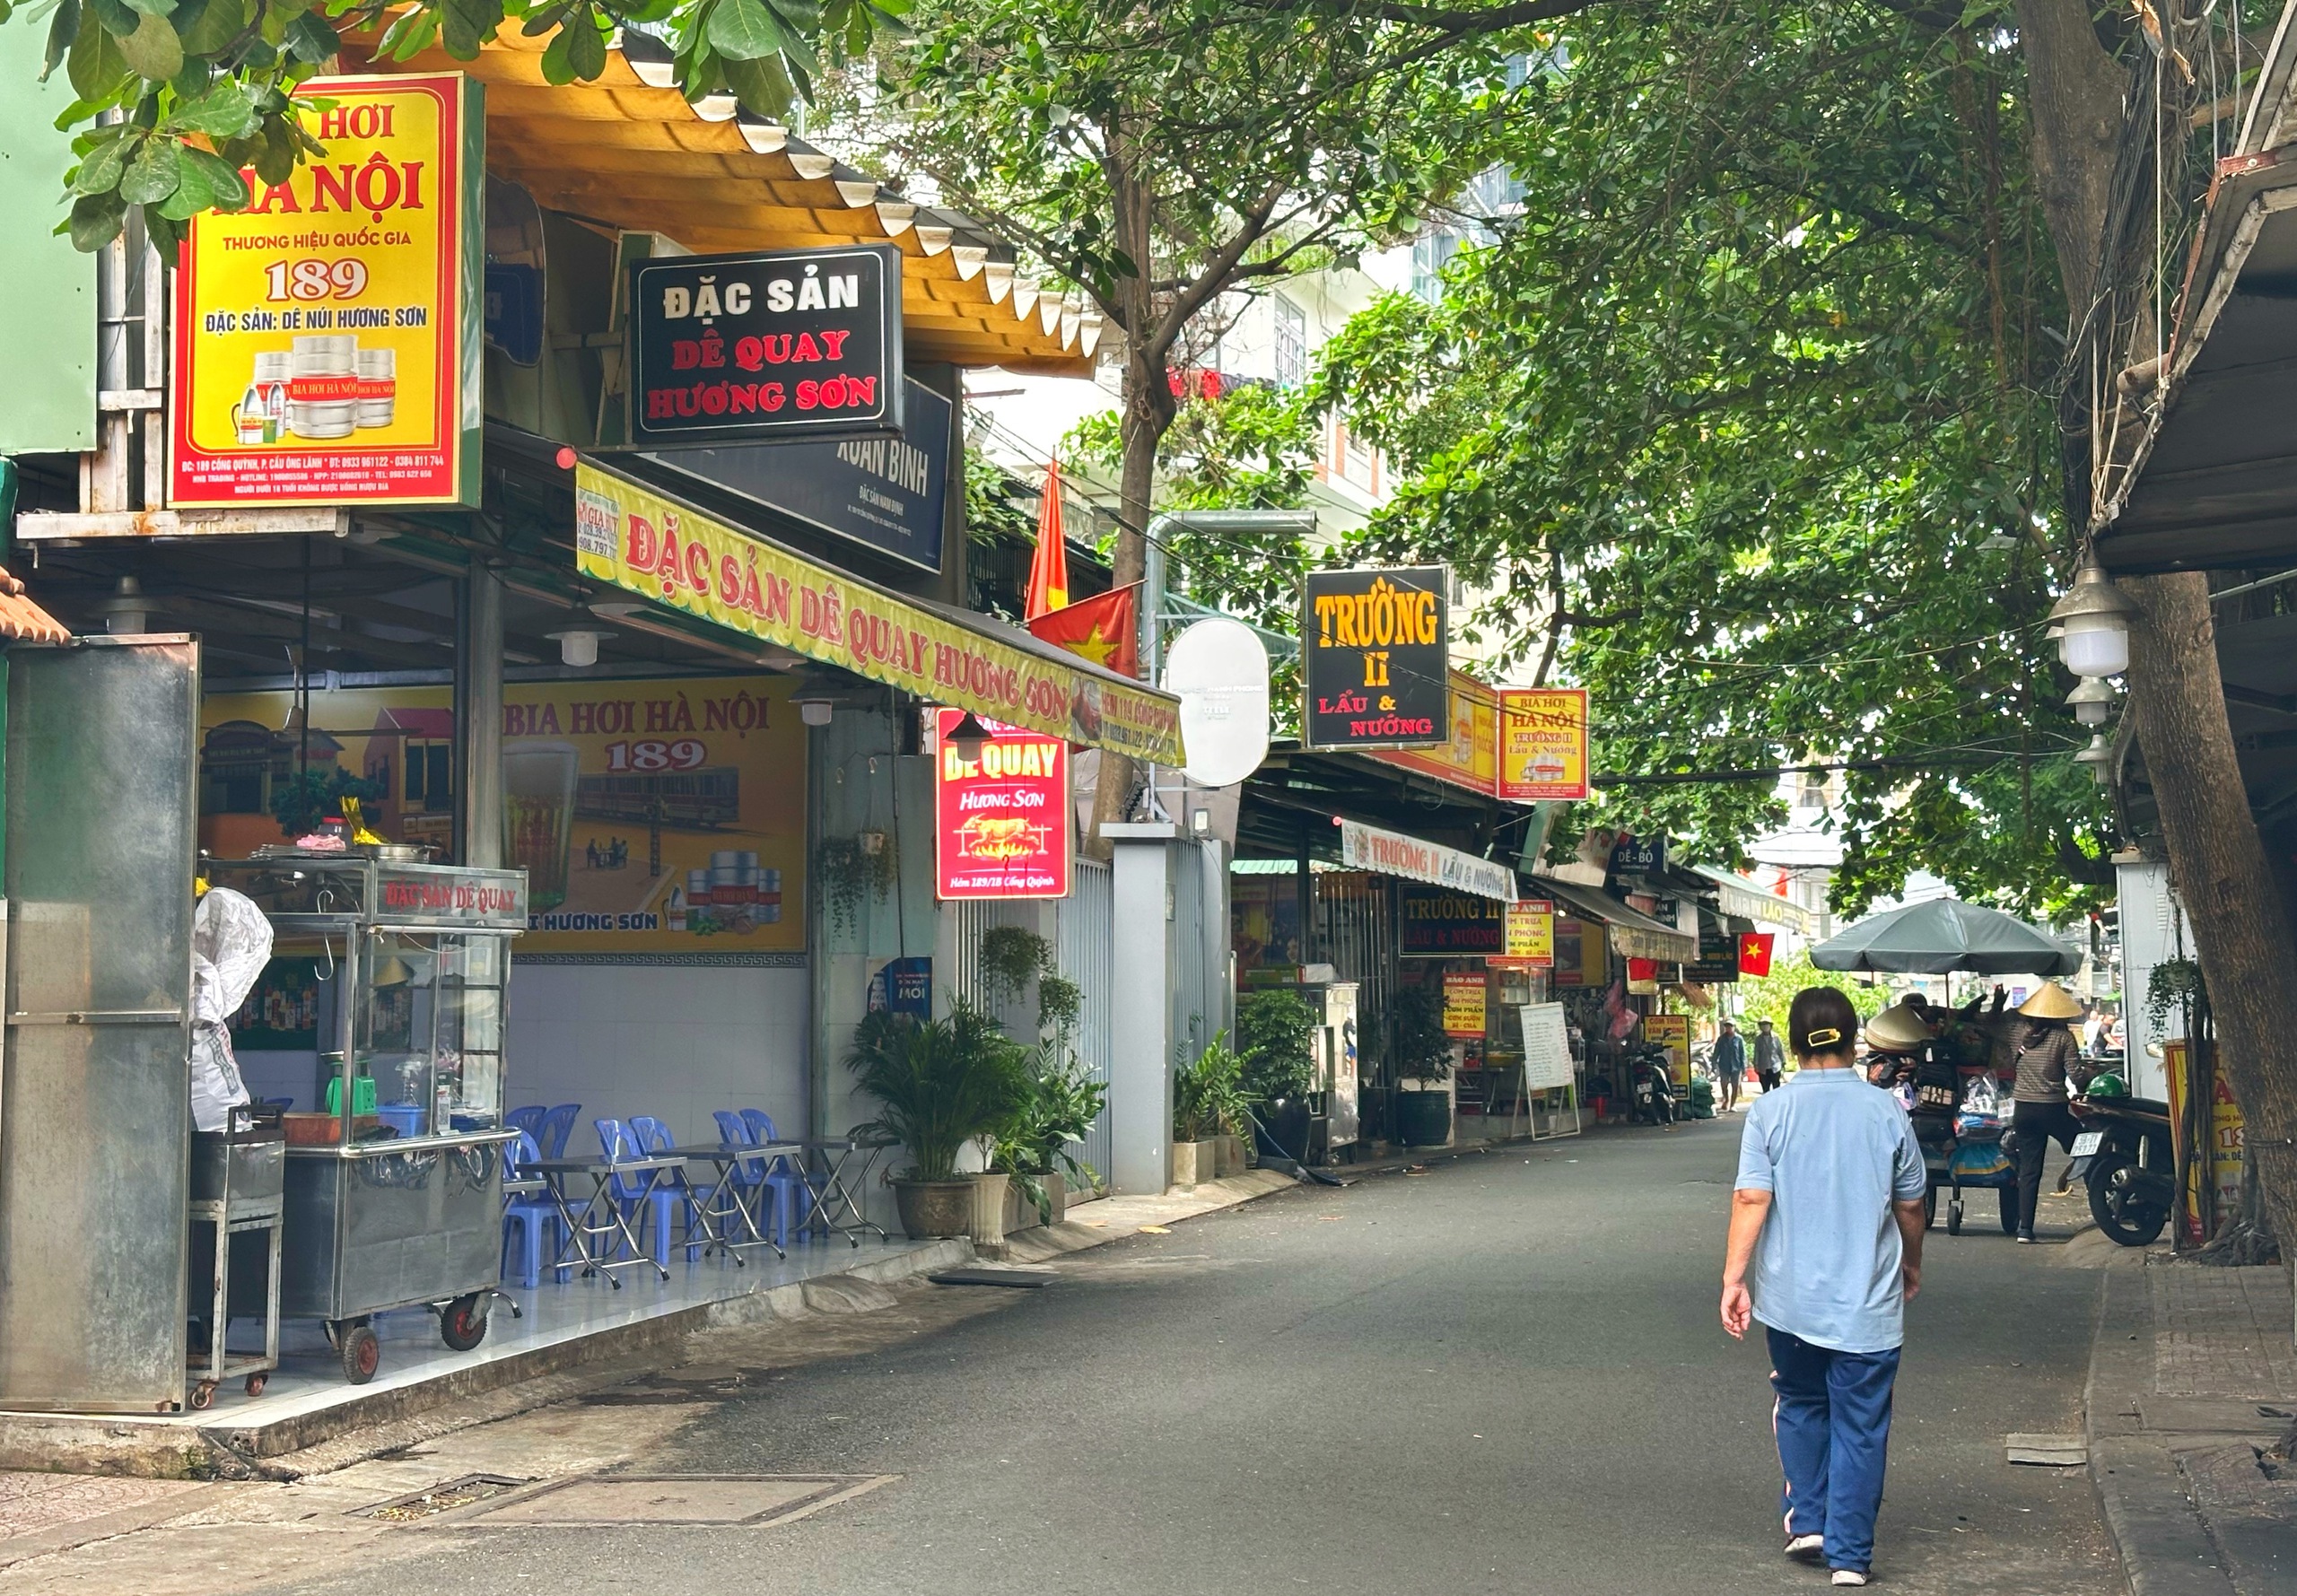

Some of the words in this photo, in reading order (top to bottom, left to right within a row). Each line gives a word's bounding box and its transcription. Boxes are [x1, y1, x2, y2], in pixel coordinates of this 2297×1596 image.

[310, 151, 424, 223] NỘI
[223, 235, 289, 251] THƯƠNG
[293, 231, 332, 251] HIỆU
[333, 225, 380, 248] QUỐC
[384, 231, 412, 247] GIA
[265, 257, 369, 302] 189
[663, 275, 751, 325] ĐẶC
[767, 265, 859, 312] SẢN
[205, 310, 237, 336] ĐẶC
[241, 307, 277, 331] SẢN:
[282, 309, 301, 330] DÊ
[306, 306, 336, 329] NÚI
[337, 308, 389, 328] HƯƠNG
[395, 307, 427, 327] SƠN
[672, 328, 725, 370] DÊ
[735, 330, 850, 371] QUAY
[647, 380, 786, 418] HƯƠNG
[796, 373, 877, 410] SƠN
[197, 460, 209, 471] 189
[626, 510, 712, 598] ĐẶC
[721, 544, 792, 628] SẢN
[799, 583, 845, 647] DÊ
[849, 607, 928, 678] QUAY
[933, 641, 1020, 709] HƯƠNG
[1025, 666, 1070, 722] SƠN
[1314, 576, 1437, 648] TRƯỜNG
[1364, 651, 1390, 687] II
[503, 703, 563, 736] BIA
[570, 699, 636, 735] HƠI
[645, 691, 696, 733] HÀ
[703, 690, 770, 738] NỘI
[1379, 695, 1396, 711] &
[1520, 698, 1540, 708] BIA
[1543, 698, 1566, 707] HƠI
[1349, 714, 1433, 737] NƯỚNG
[1511, 712, 1536, 728] HÀ
[1541, 711, 1575, 730] NỘI
[1514, 730, 1562, 743] TRƯỜNG
[605, 738, 708, 772] 189
[983, 744, 1058, 779] QUAY
[1370, 835, 1428, 874] TRƯỜNG
[1618, 849, 1631, 862] DÊ
[1638, 850, 1654, 862] BÒ
[386, 879, 419, 912] ĐẶC
[422, 876, 451, 908] SẢN
[457, 881, 475, 908] DÊ
[478, 887, 517, 914] QUAY
[1406, 893, 1480, 920] TRƯỜNG
[1485, 899, 1499, 920] II
[1520, 904, 1547, 912] ANH
[543, 911, 613, 930] HƯƠNG
[617, 911, 658, 930] SƠN
